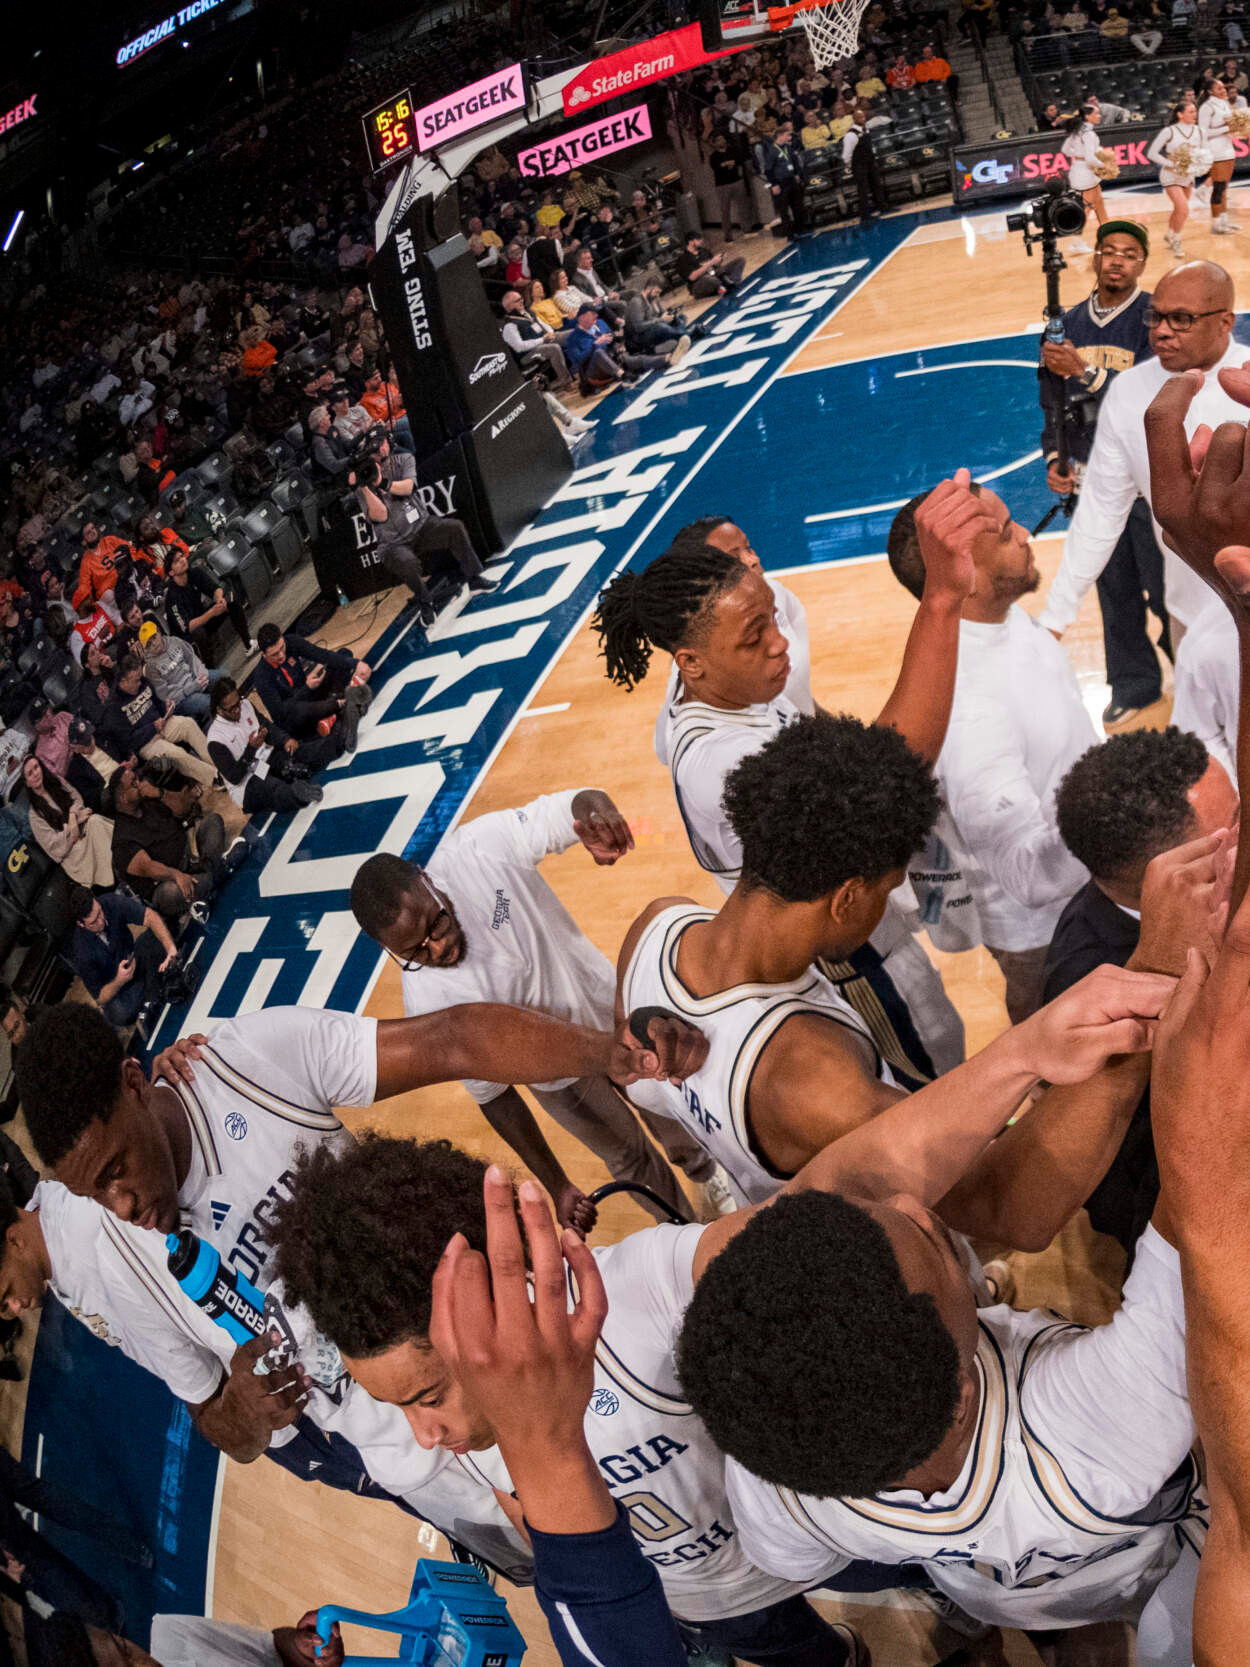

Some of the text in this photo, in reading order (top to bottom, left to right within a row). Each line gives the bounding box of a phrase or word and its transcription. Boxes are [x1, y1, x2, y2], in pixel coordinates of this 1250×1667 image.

[117, 0, 224, 64] OFFICIAL TICKE
[376, 99, 410, 131] 15:16
[423, 75, 517, 138] SEATGEEK
[382, 123, 408, 156] 25
[523, 112, 644, 178] SEATGEEK
[404, 277, 433, 350] STING
[612, 259, 870, 425] TECH
[351, 475, 457, 549] ERY
[176, 427, 706, 1042] EORGIA
[491, 889, 504, 930] GEORGIA
[501, 898, 511, 925] TECH
[214, 1282, 267, 1335] ERADE
[636, 1519, 733, 1566] ECH
